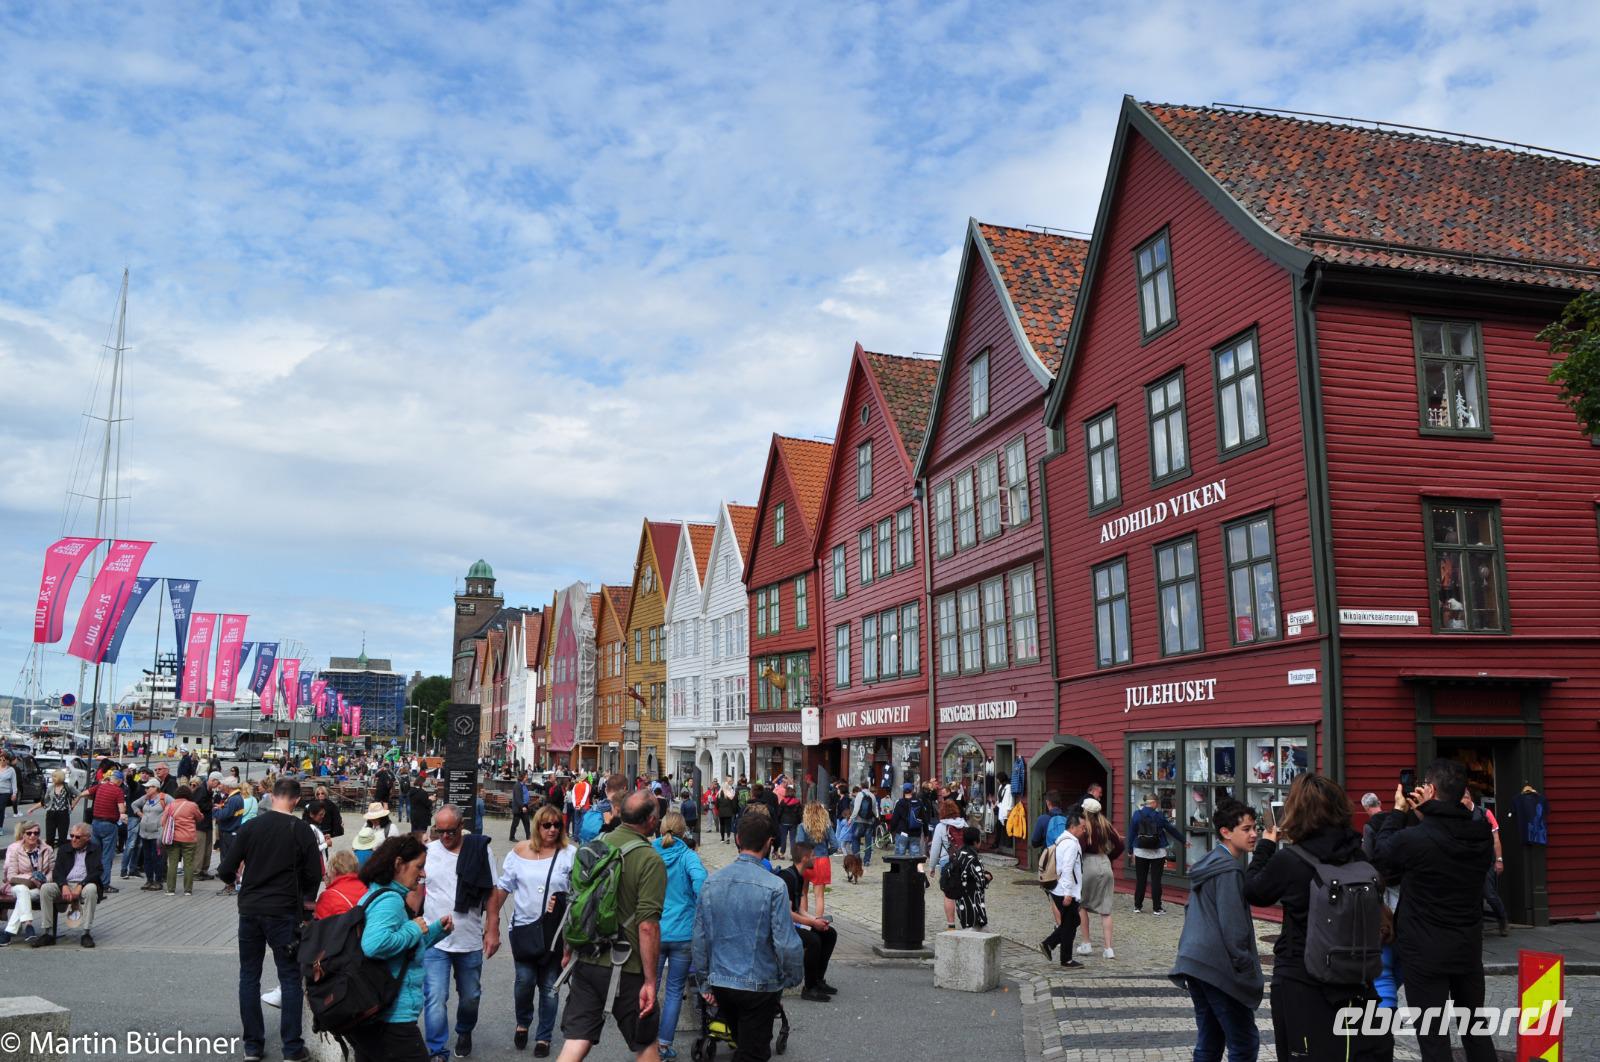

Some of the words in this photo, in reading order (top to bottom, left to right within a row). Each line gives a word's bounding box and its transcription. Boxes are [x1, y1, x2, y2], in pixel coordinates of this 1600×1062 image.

[1100, 502, 1168, 544] AUDHILD
[1168, 478, 1227, 518] VIKEN
[1290, 613, 1309, 624] Bryggen
[1124, 678, 1217, 712] JULEHUSET
[836, 711, 857, 729] KNUT
[860, 705, 911, 726] SKURTVEIT
[940, 704, 976, 723] BRYGGEN
[978, 700, 1018, 721] HUSFLID
